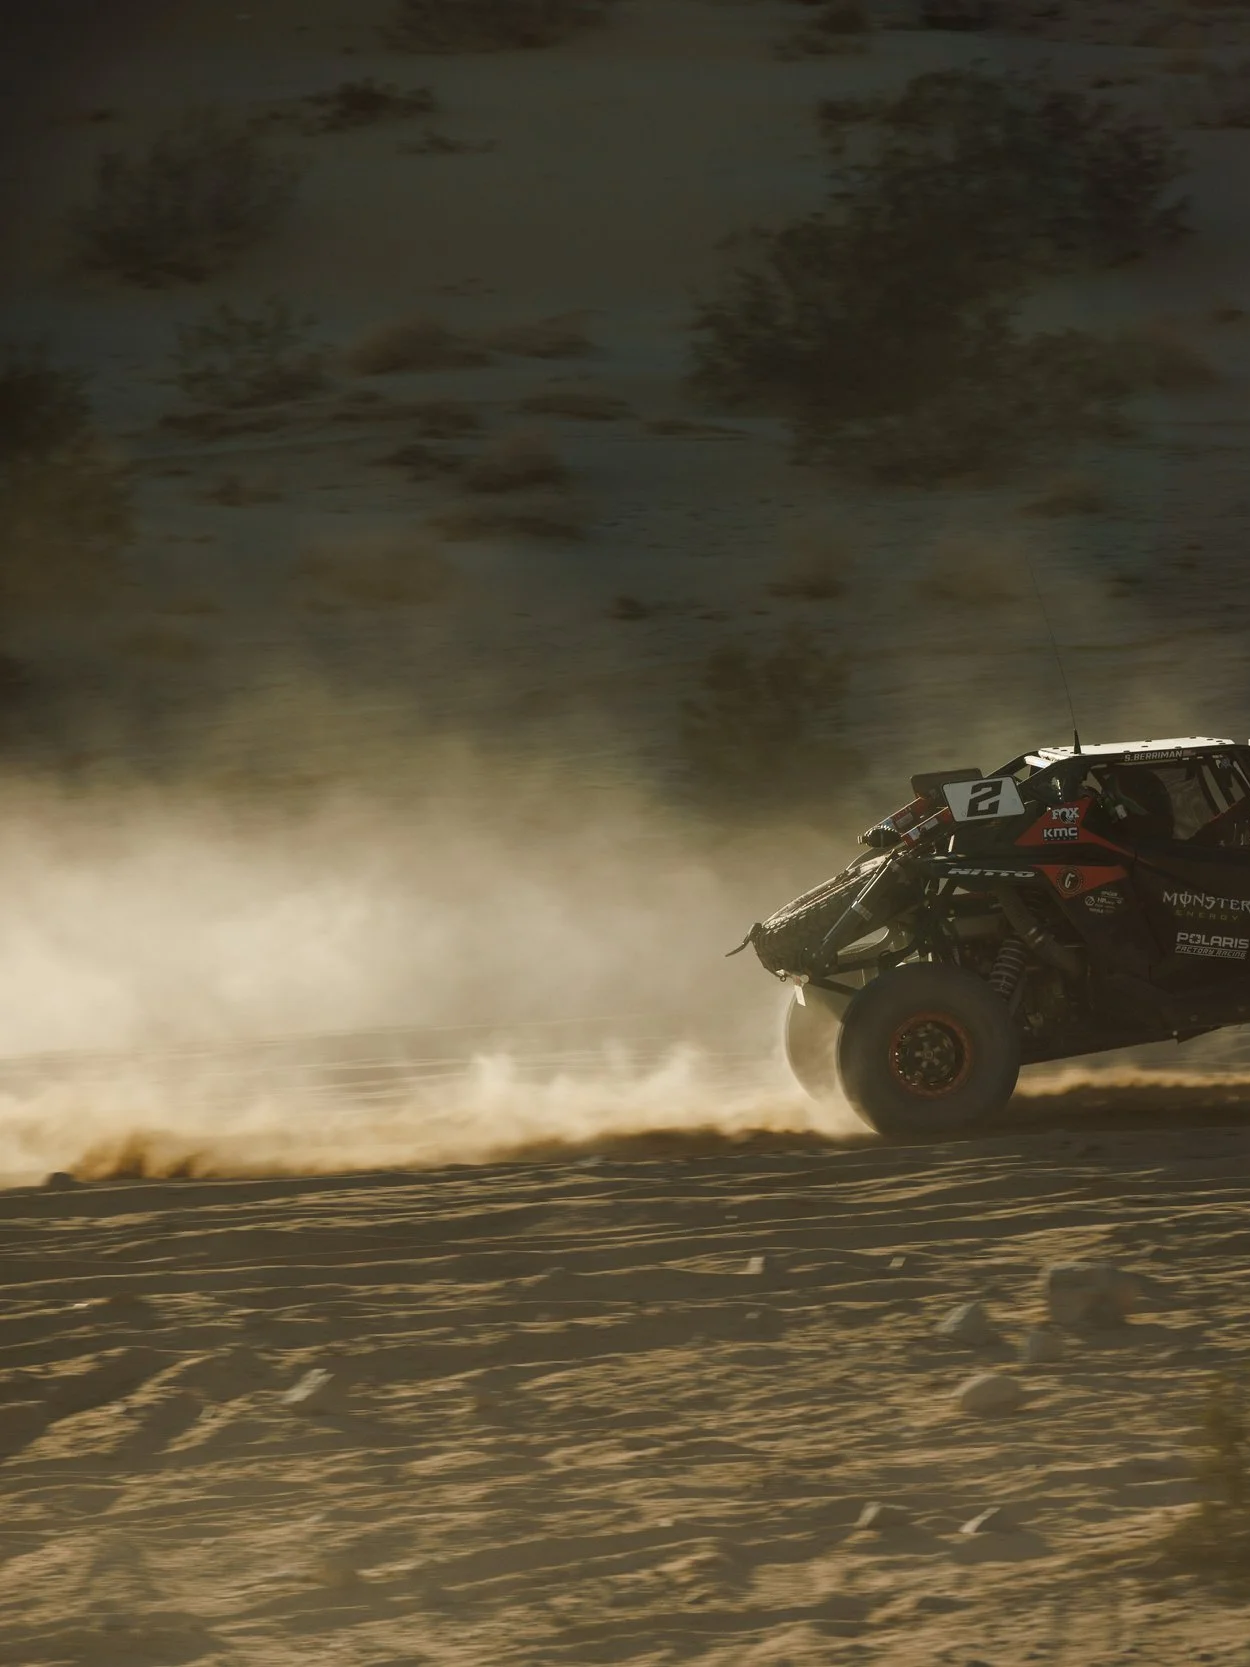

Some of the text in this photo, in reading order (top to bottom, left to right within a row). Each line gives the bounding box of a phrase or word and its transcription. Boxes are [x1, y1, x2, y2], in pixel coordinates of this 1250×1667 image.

[1124, 749, 1183, 762] S.BERRIMAN
[966, 780, 1003, 818] 2
[1051, 807, 1080, 825] FOX
[1043, 827, 1078, 838] KMC
[947, 867, 1035, 878] NITTO
[1175, 909, 1239, 921] ENERGY
[1176, 931, 1250, 950] POLARIS
[1175, 945, 1247, 958] FACTORY RACING
